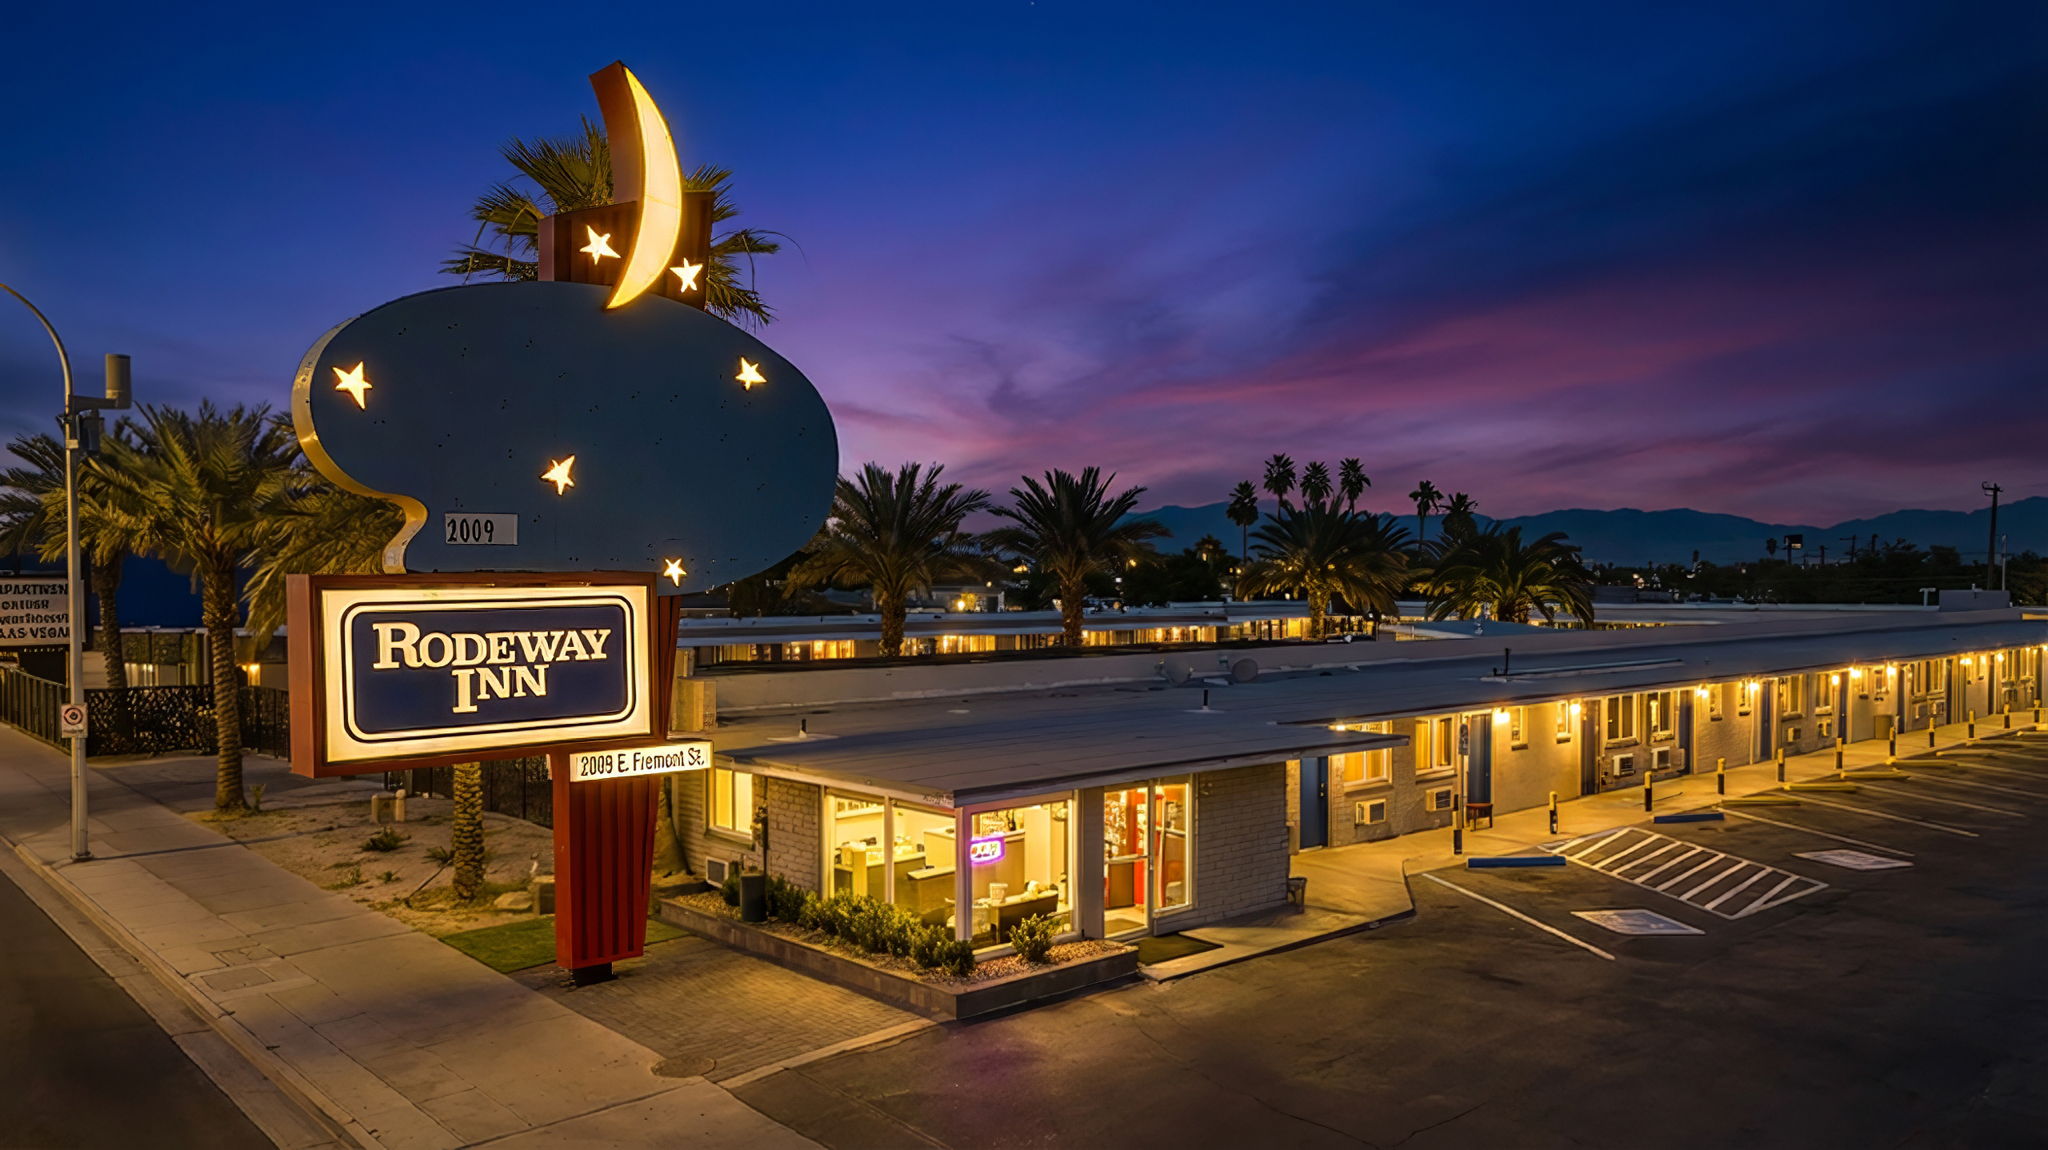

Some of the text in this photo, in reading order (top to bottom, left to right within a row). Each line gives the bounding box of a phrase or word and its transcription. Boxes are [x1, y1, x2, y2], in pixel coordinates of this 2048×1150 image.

[447, 518, 495, 543] 2009
[372, 621, 612, 671] RODEWAY
[451, 663, 550, 714] INN
